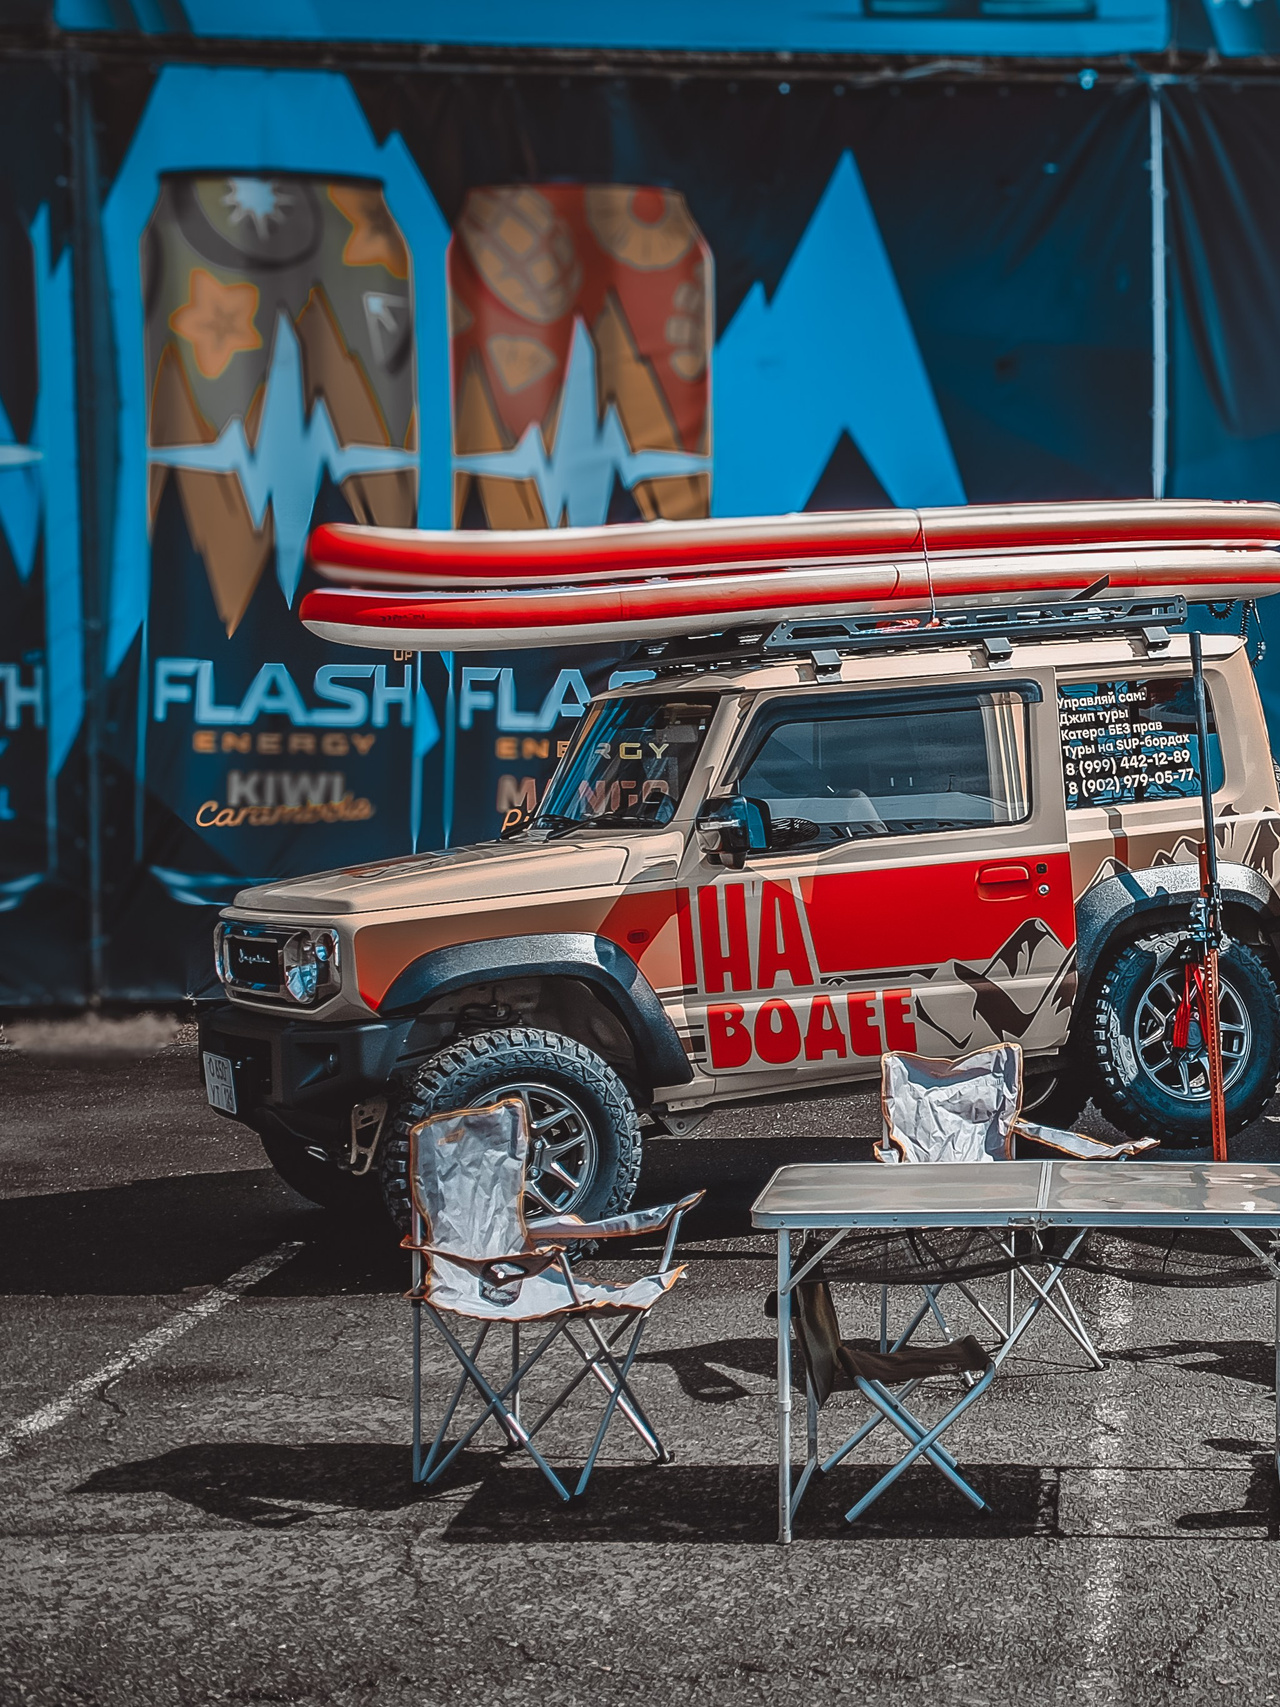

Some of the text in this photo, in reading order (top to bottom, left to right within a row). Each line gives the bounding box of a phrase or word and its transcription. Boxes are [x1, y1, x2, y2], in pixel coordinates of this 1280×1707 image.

[154, 656, 412, 728] FLASH
[459, 667, 656, 732] FLA
[1057, 691, 1147, 709] Управляй сам:
[1059, 709, 1129, 726] Джип туры
[1061, 721, 1163, 741] Катера БЕЗ прав
[192, 730, 376, 756] ENERGY
[1063, 734, 1190, 759] Туры на SUP-бордах
[1065, 749, 1191, 778] 8 (999) 442-12-89
[227, 770, 345, 807] KIWI
[1068, 767, 1194, 798] 8 (902) 979-05-77
[697, 879, 814, 993] НА
